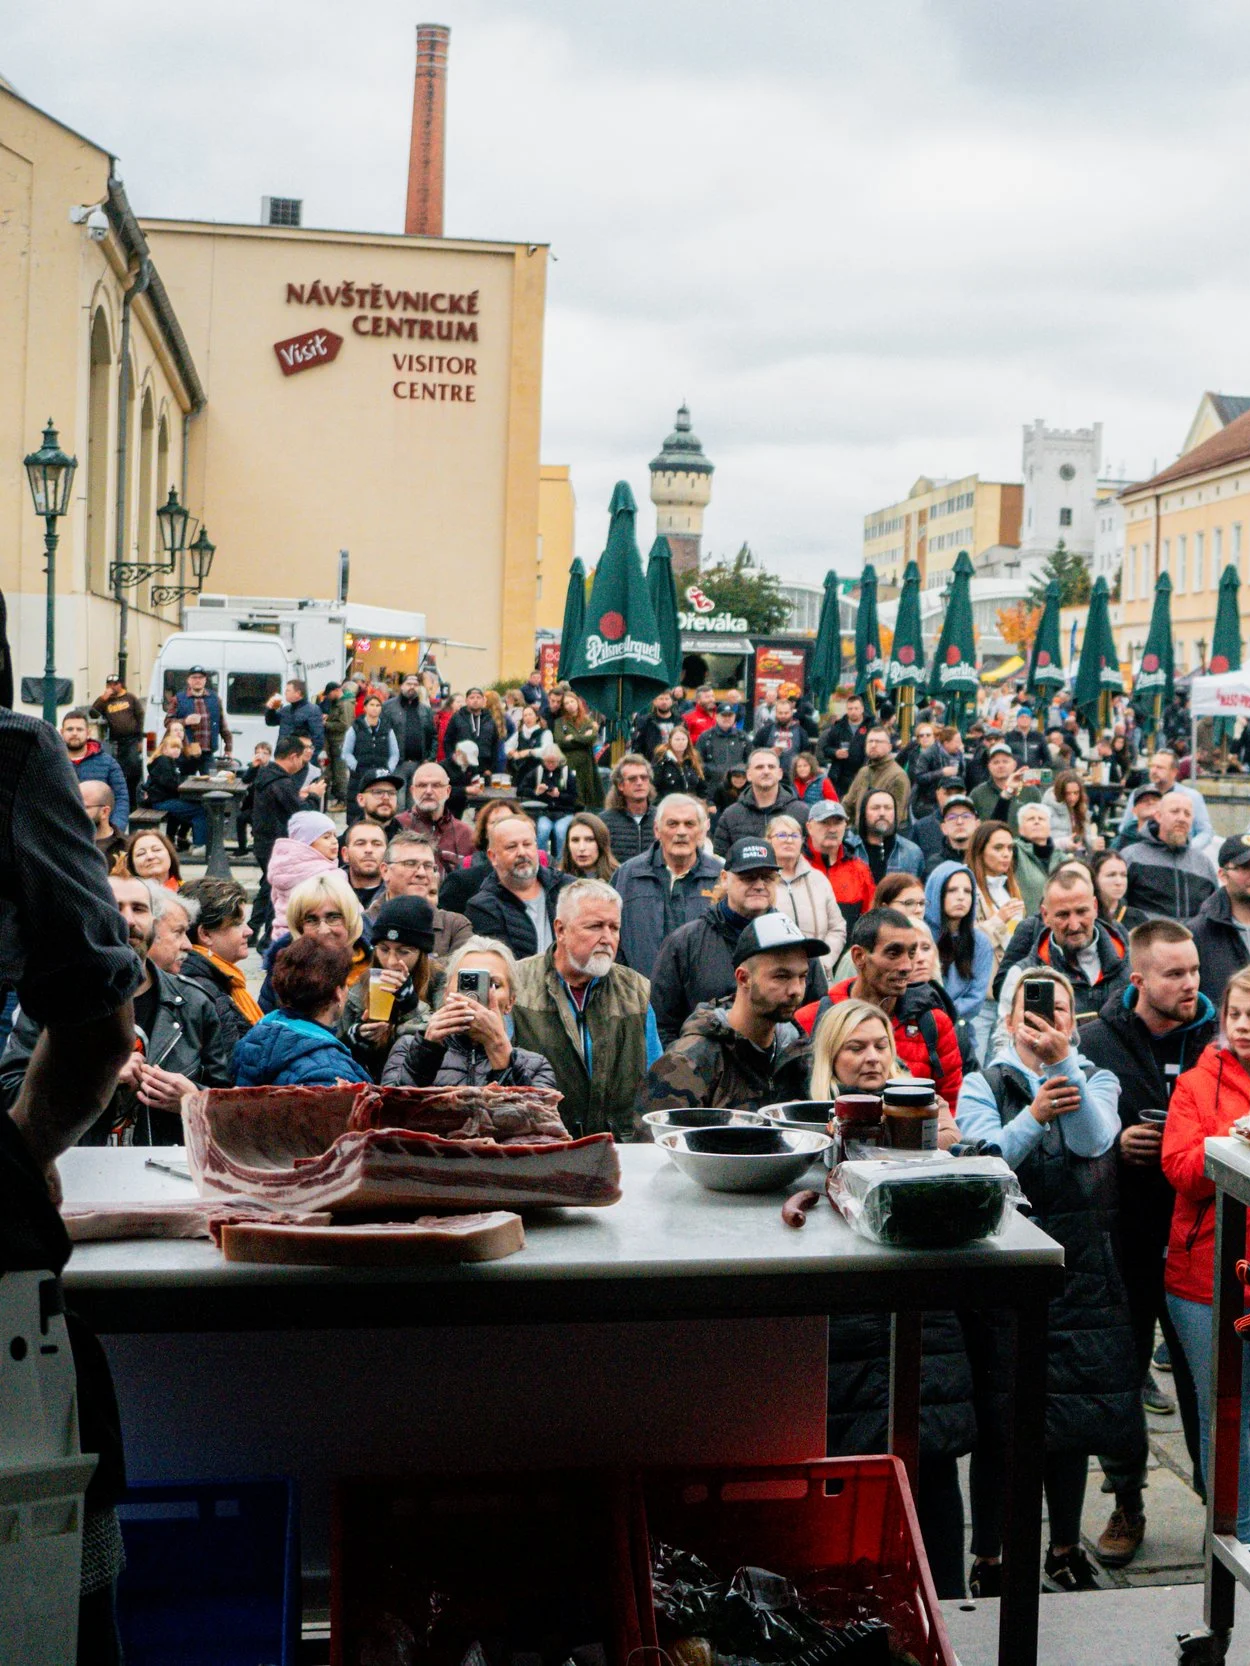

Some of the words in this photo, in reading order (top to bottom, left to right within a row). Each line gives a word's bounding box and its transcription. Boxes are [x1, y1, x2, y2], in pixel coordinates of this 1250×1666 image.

[286, 279, 480, 316] NÁVŠTĚVNICKÉ
[352, 315, 479, 342] CENTRUM
[280, 334, 328, 367] Visit
[392, 353, 477, 375] VISITOR
[393, 381, 476, 402] CENTRE
